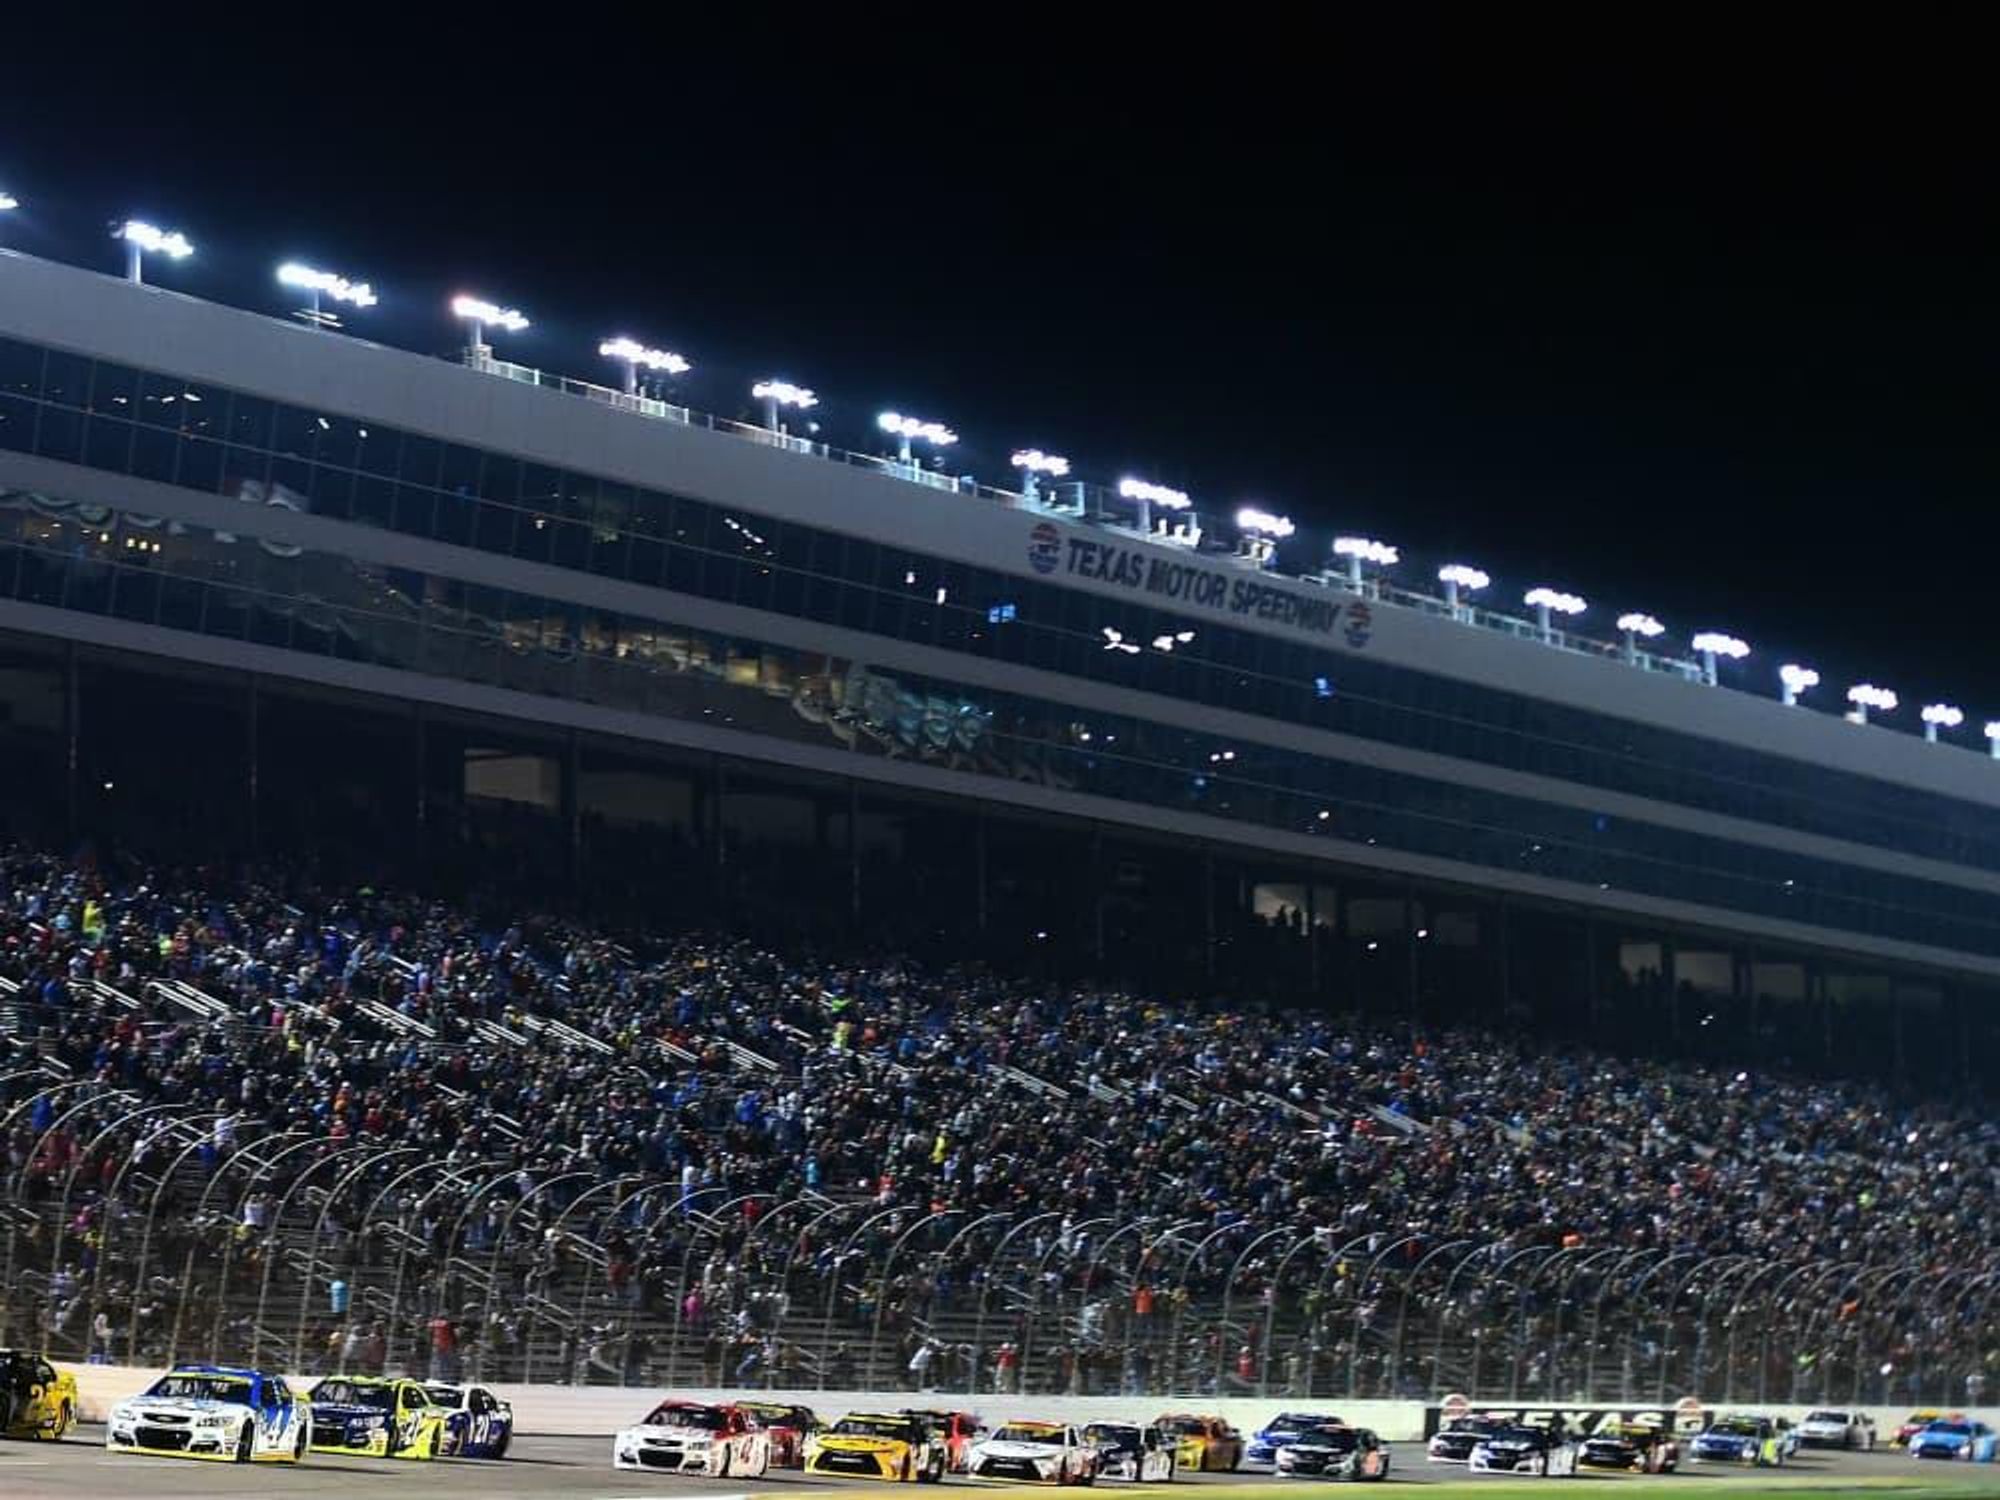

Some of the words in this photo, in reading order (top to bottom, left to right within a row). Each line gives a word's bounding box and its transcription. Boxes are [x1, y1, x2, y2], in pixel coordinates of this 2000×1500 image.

[1067, 539, 1143, 587] TEXAS
[1146, 558, 1228, 608] MOTOR
[1230, 580, 1341, 633] SPEEDWAY
